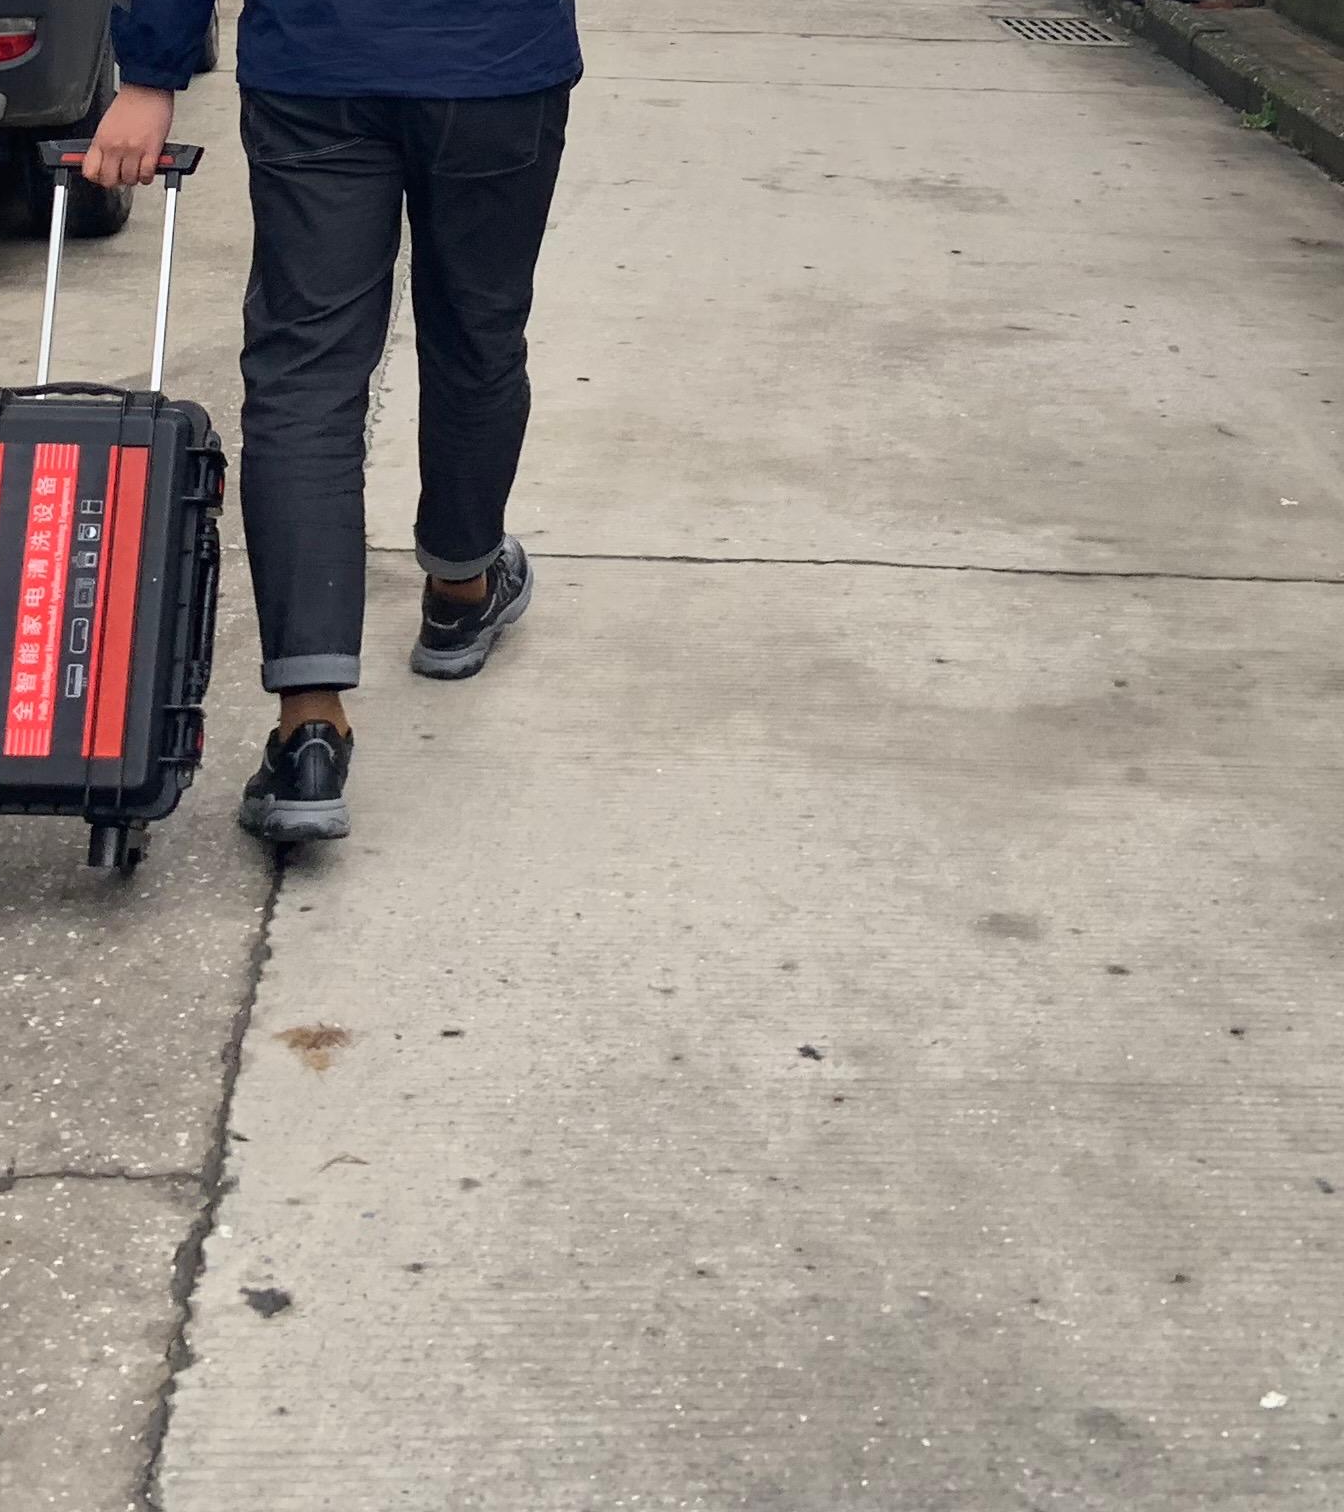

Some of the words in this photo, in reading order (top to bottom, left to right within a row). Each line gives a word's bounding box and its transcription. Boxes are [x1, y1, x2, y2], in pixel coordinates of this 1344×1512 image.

[12, 475, 58, 722] 全智能家电清洗设备
